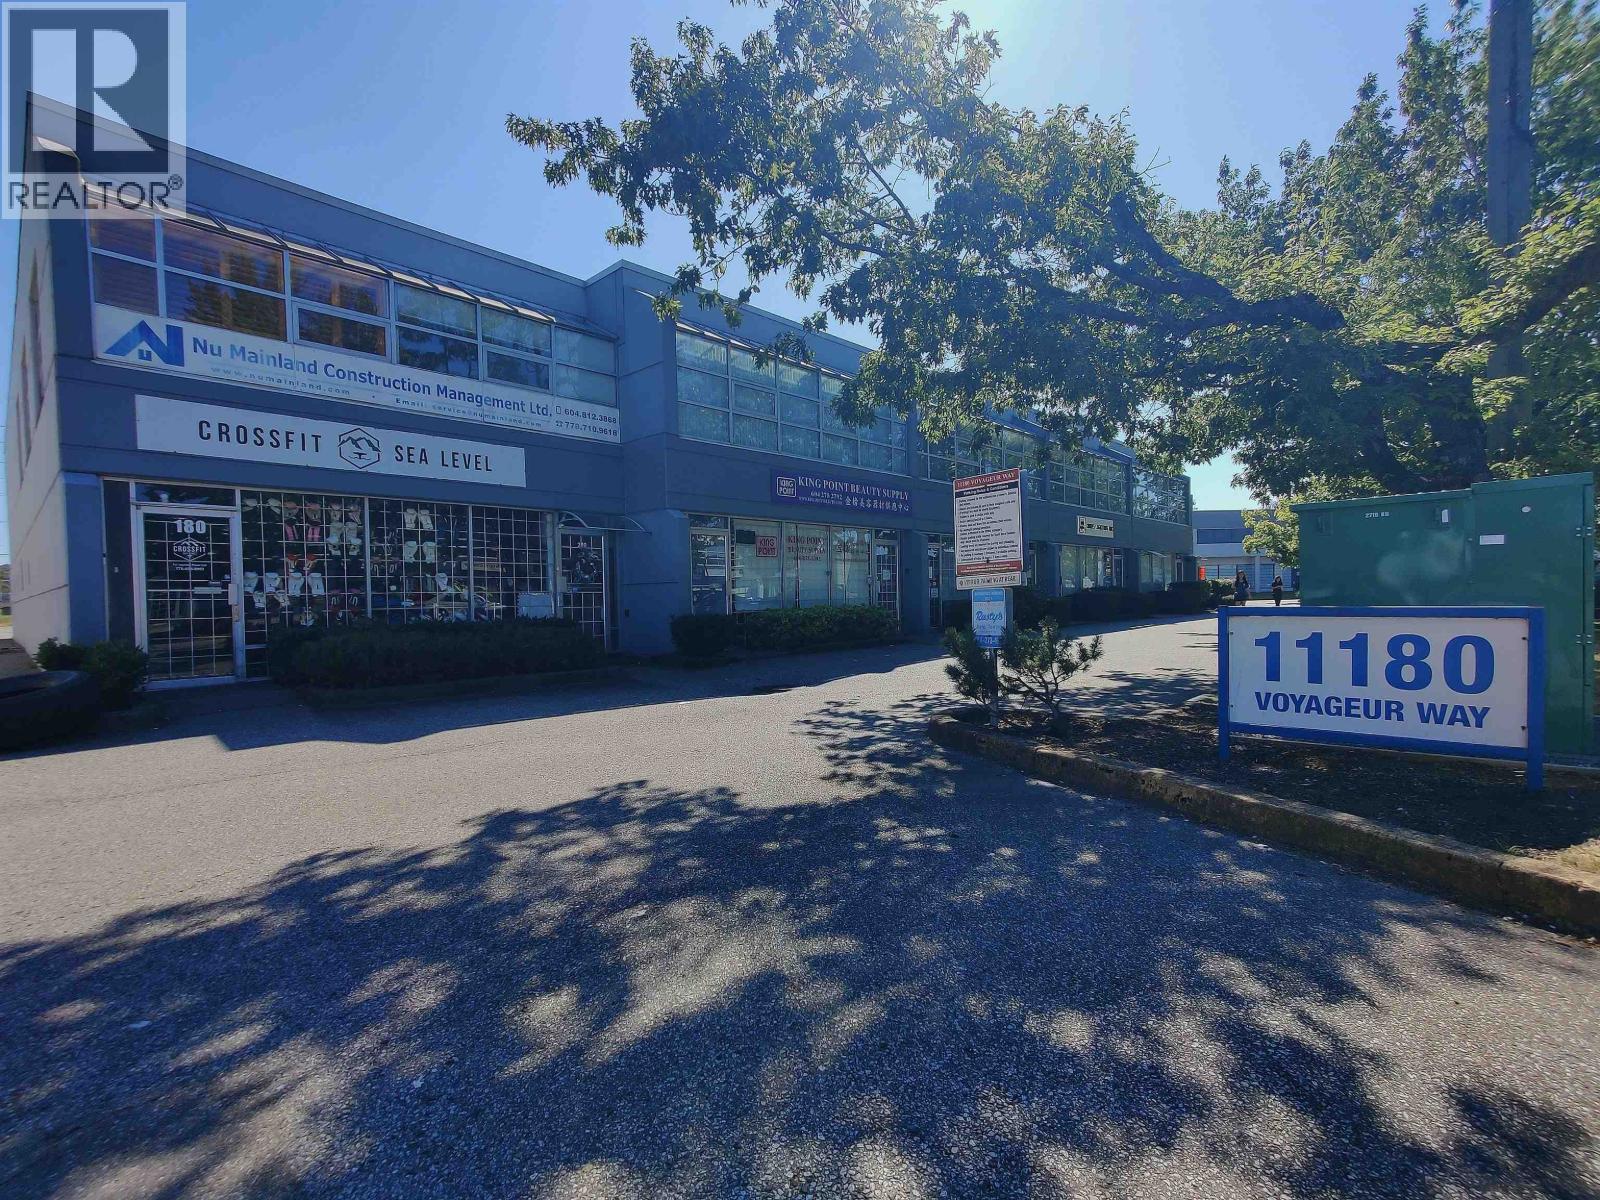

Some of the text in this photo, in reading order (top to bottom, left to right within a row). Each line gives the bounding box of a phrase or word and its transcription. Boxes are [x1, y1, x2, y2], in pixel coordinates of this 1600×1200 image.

[192, 336, 553, 417] Nu Mainland Construction Management Ltd.
[210, 366, 351, 396] www.numainland.com
[198, 420, 322, 453] CROSSFIT
[394, 444, 493, 472] SEA LEVEL
[798, 476, 909, 501] KING POINT BEAUTY SUPPLY
[176, 519, 207, 534] 180
[173, 545, 207, 553] CROSSFIT
[1254, 631, 1495, 695] 11180
[1254, 691, 1491, 729] VOYAGEUR WAY
